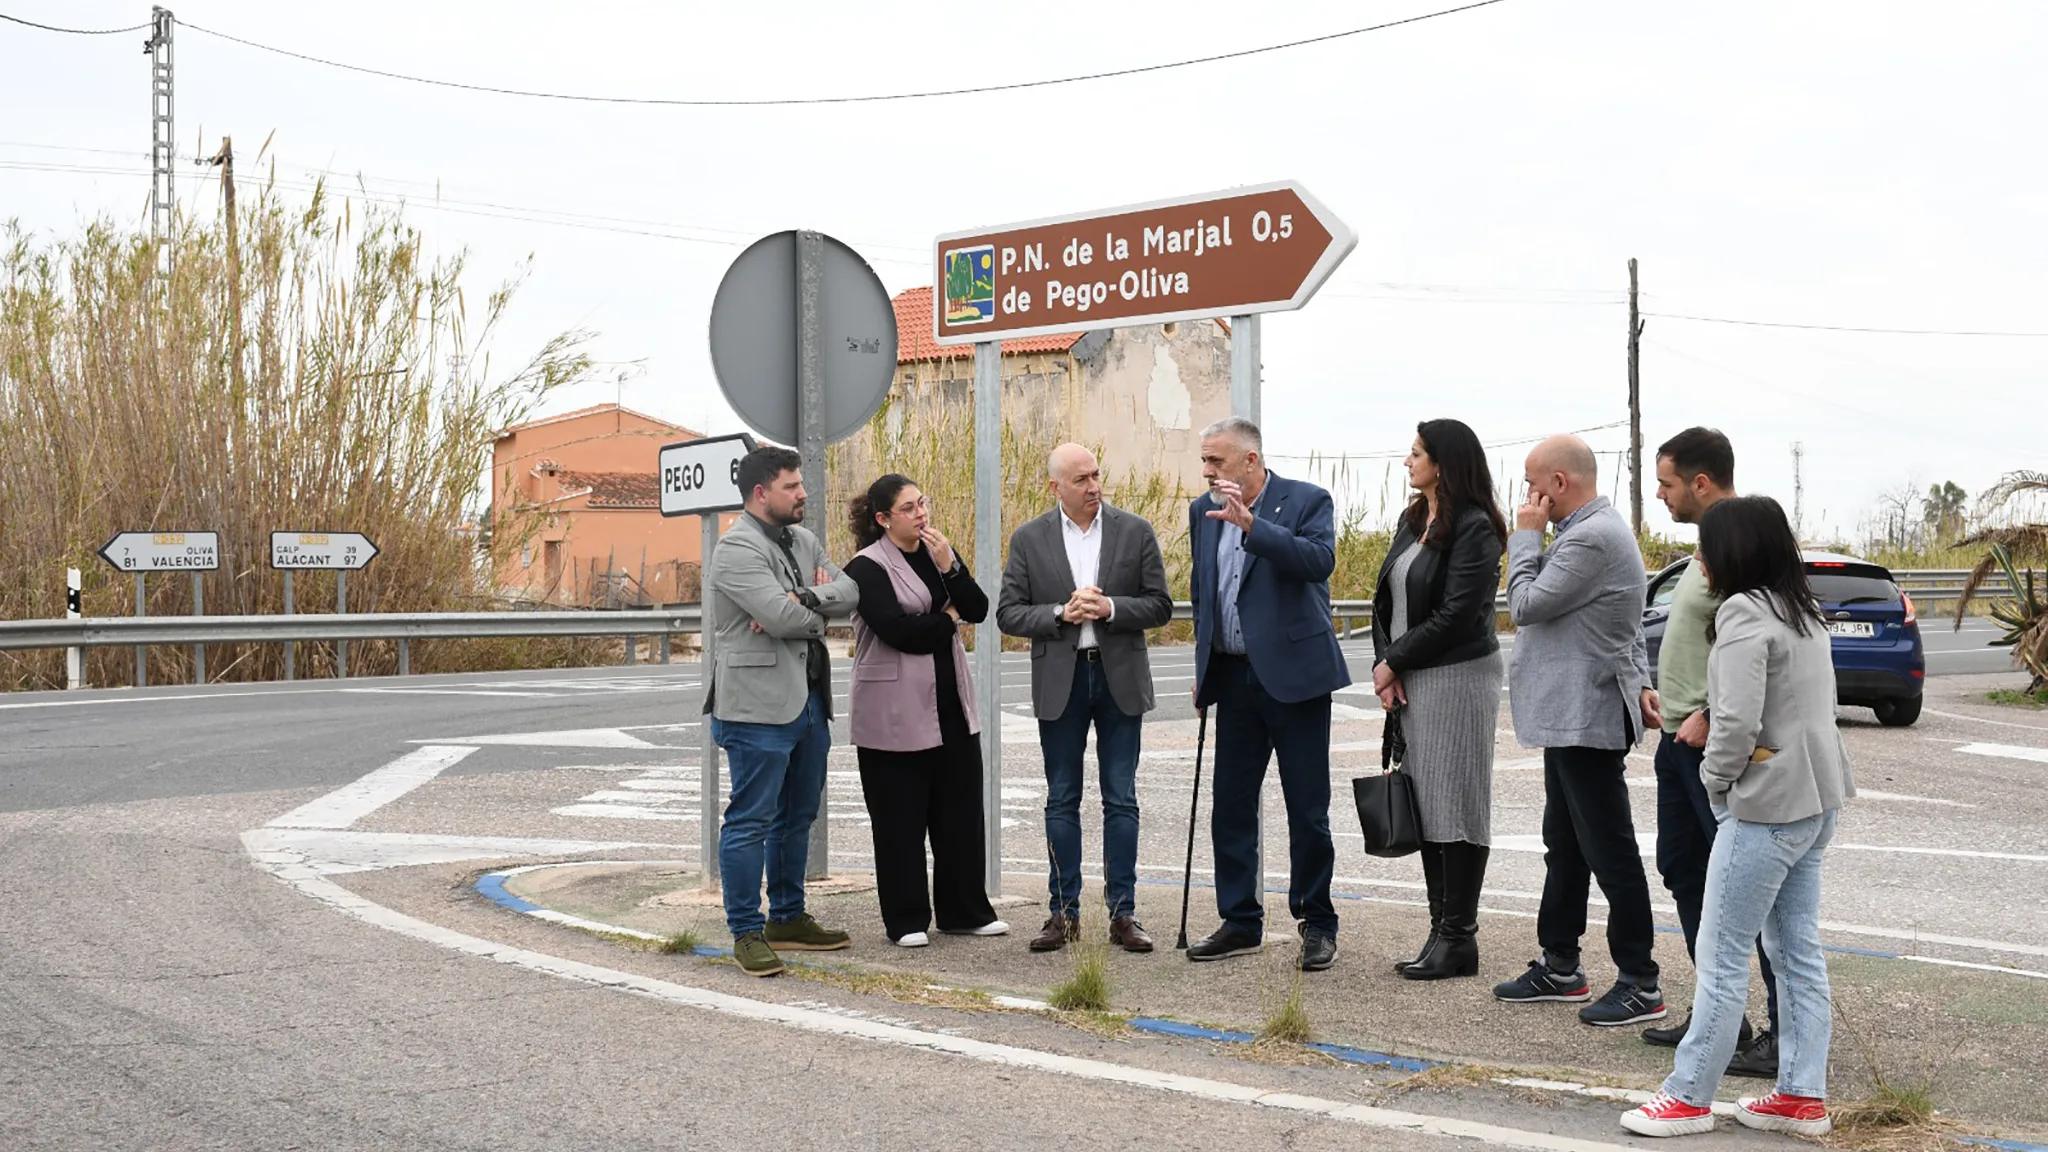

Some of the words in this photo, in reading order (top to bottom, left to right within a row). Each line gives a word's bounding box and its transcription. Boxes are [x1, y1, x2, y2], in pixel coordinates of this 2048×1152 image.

[1001, 244, 1050, 276] P.N.
[1062, 237, 1093, 267] de
[1105, 231, 1130, 262] la
[1143, 215, 1233, 257] Marjal
[1252, 209, 1294, 243] 0,5
[1002, 285, 1031, 315] de
[1046, 268, 1189, 313] Pego-Oliva
[665, 462, 704, 493] PEGO
[186, 546, 214, 555] OLIVA
[276, 546, 299, 554] CALP
[346, 546, 356, 554] 39
[123, 557, 136, 568] 81
[152, 556, 214, 567] VALENCIA
[277, 555, 331, 566] ALACANT
[344, 555, 357, 566] 97
